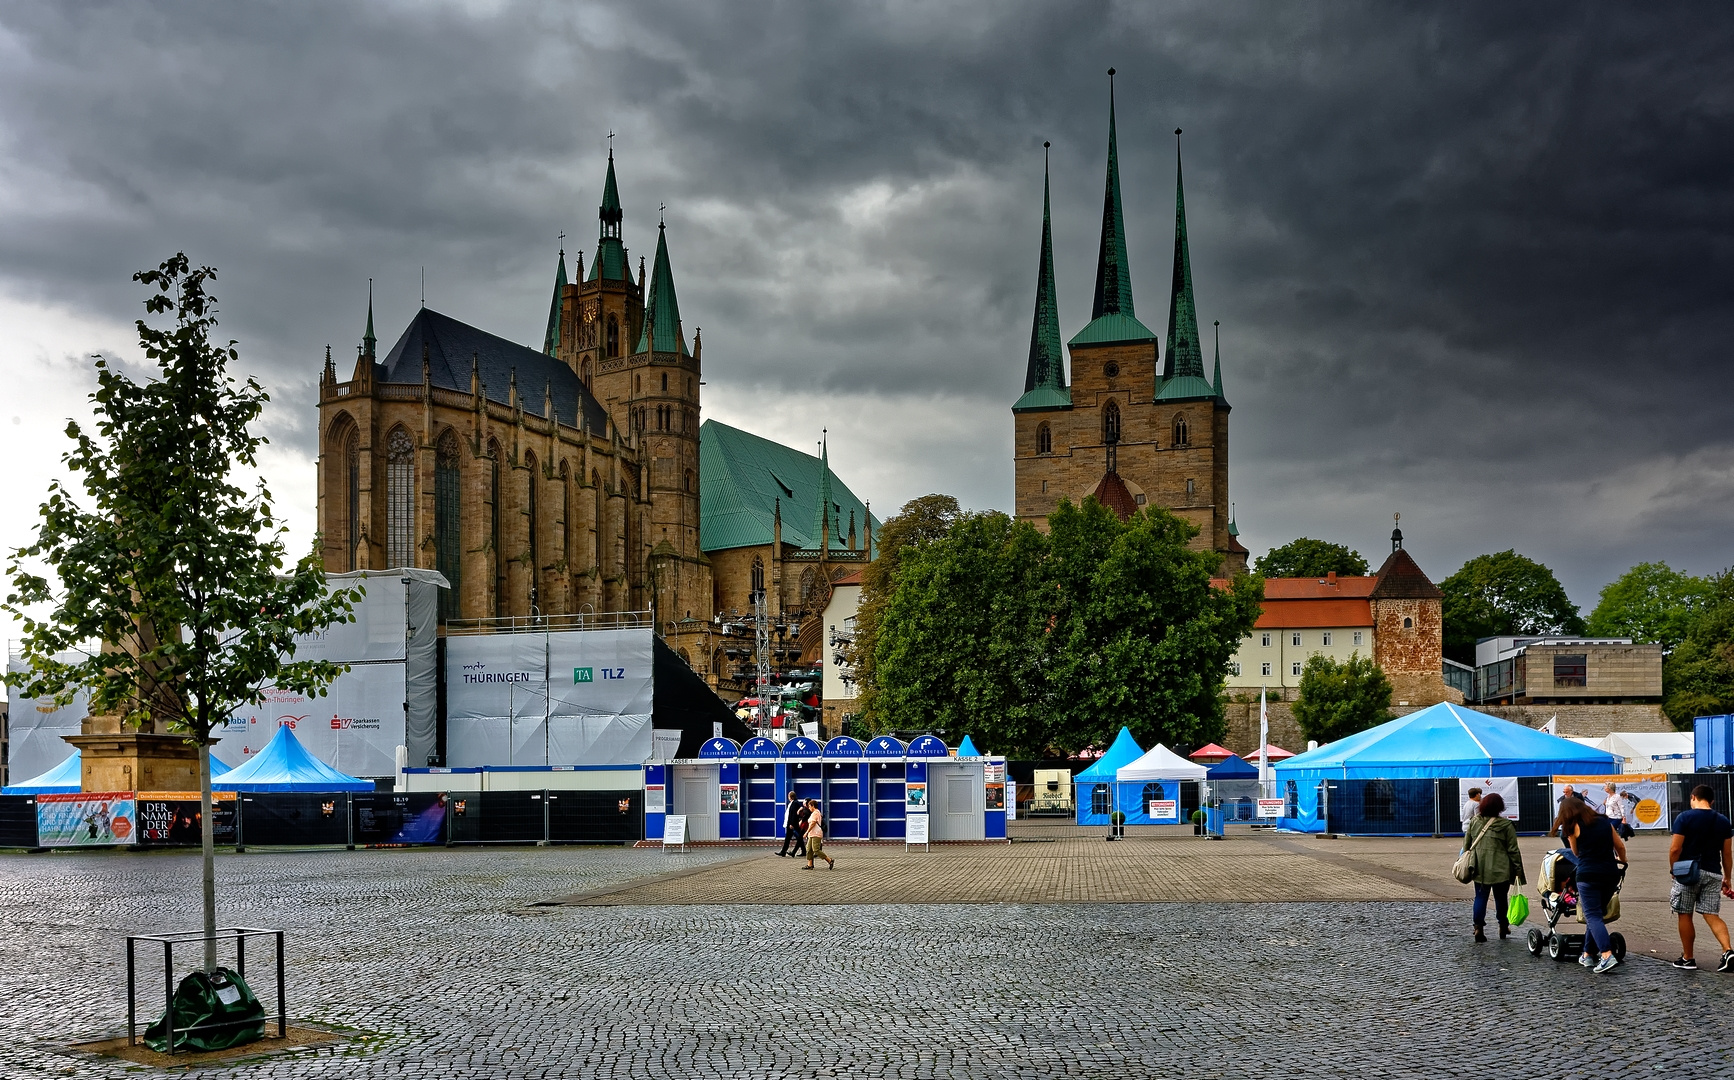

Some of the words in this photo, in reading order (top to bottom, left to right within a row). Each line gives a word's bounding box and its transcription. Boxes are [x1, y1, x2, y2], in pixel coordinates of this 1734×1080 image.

[463, 662, 486, 671] mdr
[463, 672, 530, 684] THÜRINGEN
[576, 670, 591, 680] TA
[601, 668, 625, 679] TLZ
[146, 802, 168, 813] DER
[140, 811, 173, 821] NAME
[147, 820, 169, 830] DER
